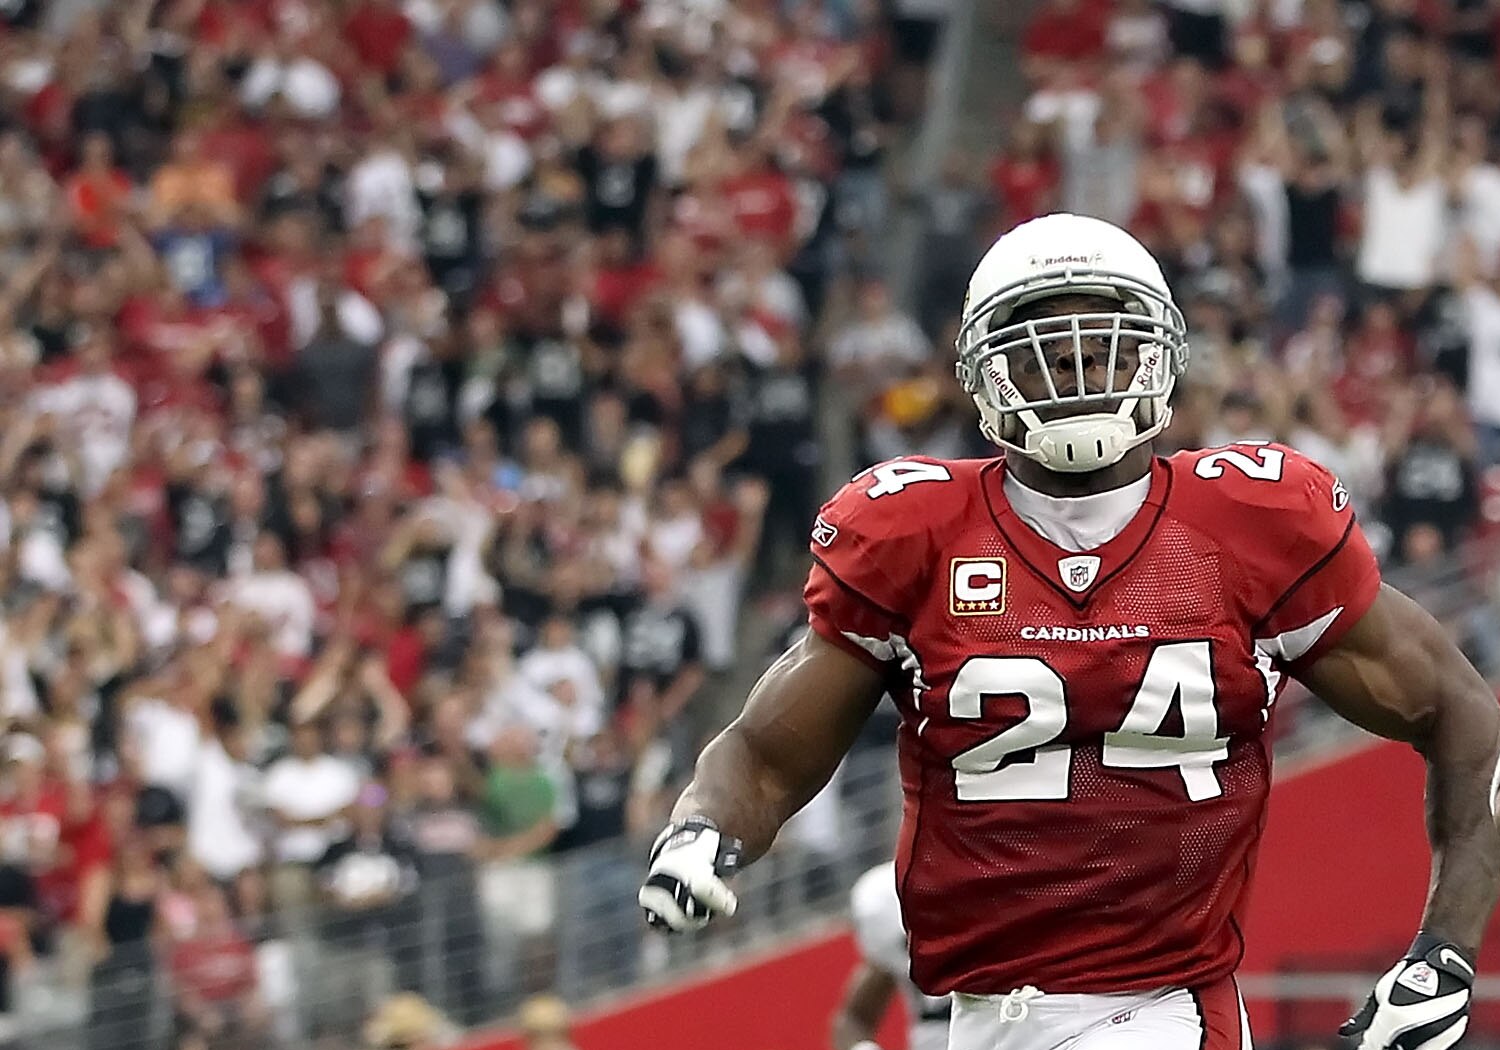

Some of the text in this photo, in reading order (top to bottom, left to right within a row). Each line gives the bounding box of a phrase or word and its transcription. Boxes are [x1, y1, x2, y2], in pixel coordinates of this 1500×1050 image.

[952, 561, 1003, 602] C
[1020, 624, 1150, 642] CARDINALS
[948, 640, 1231, 802] 24
